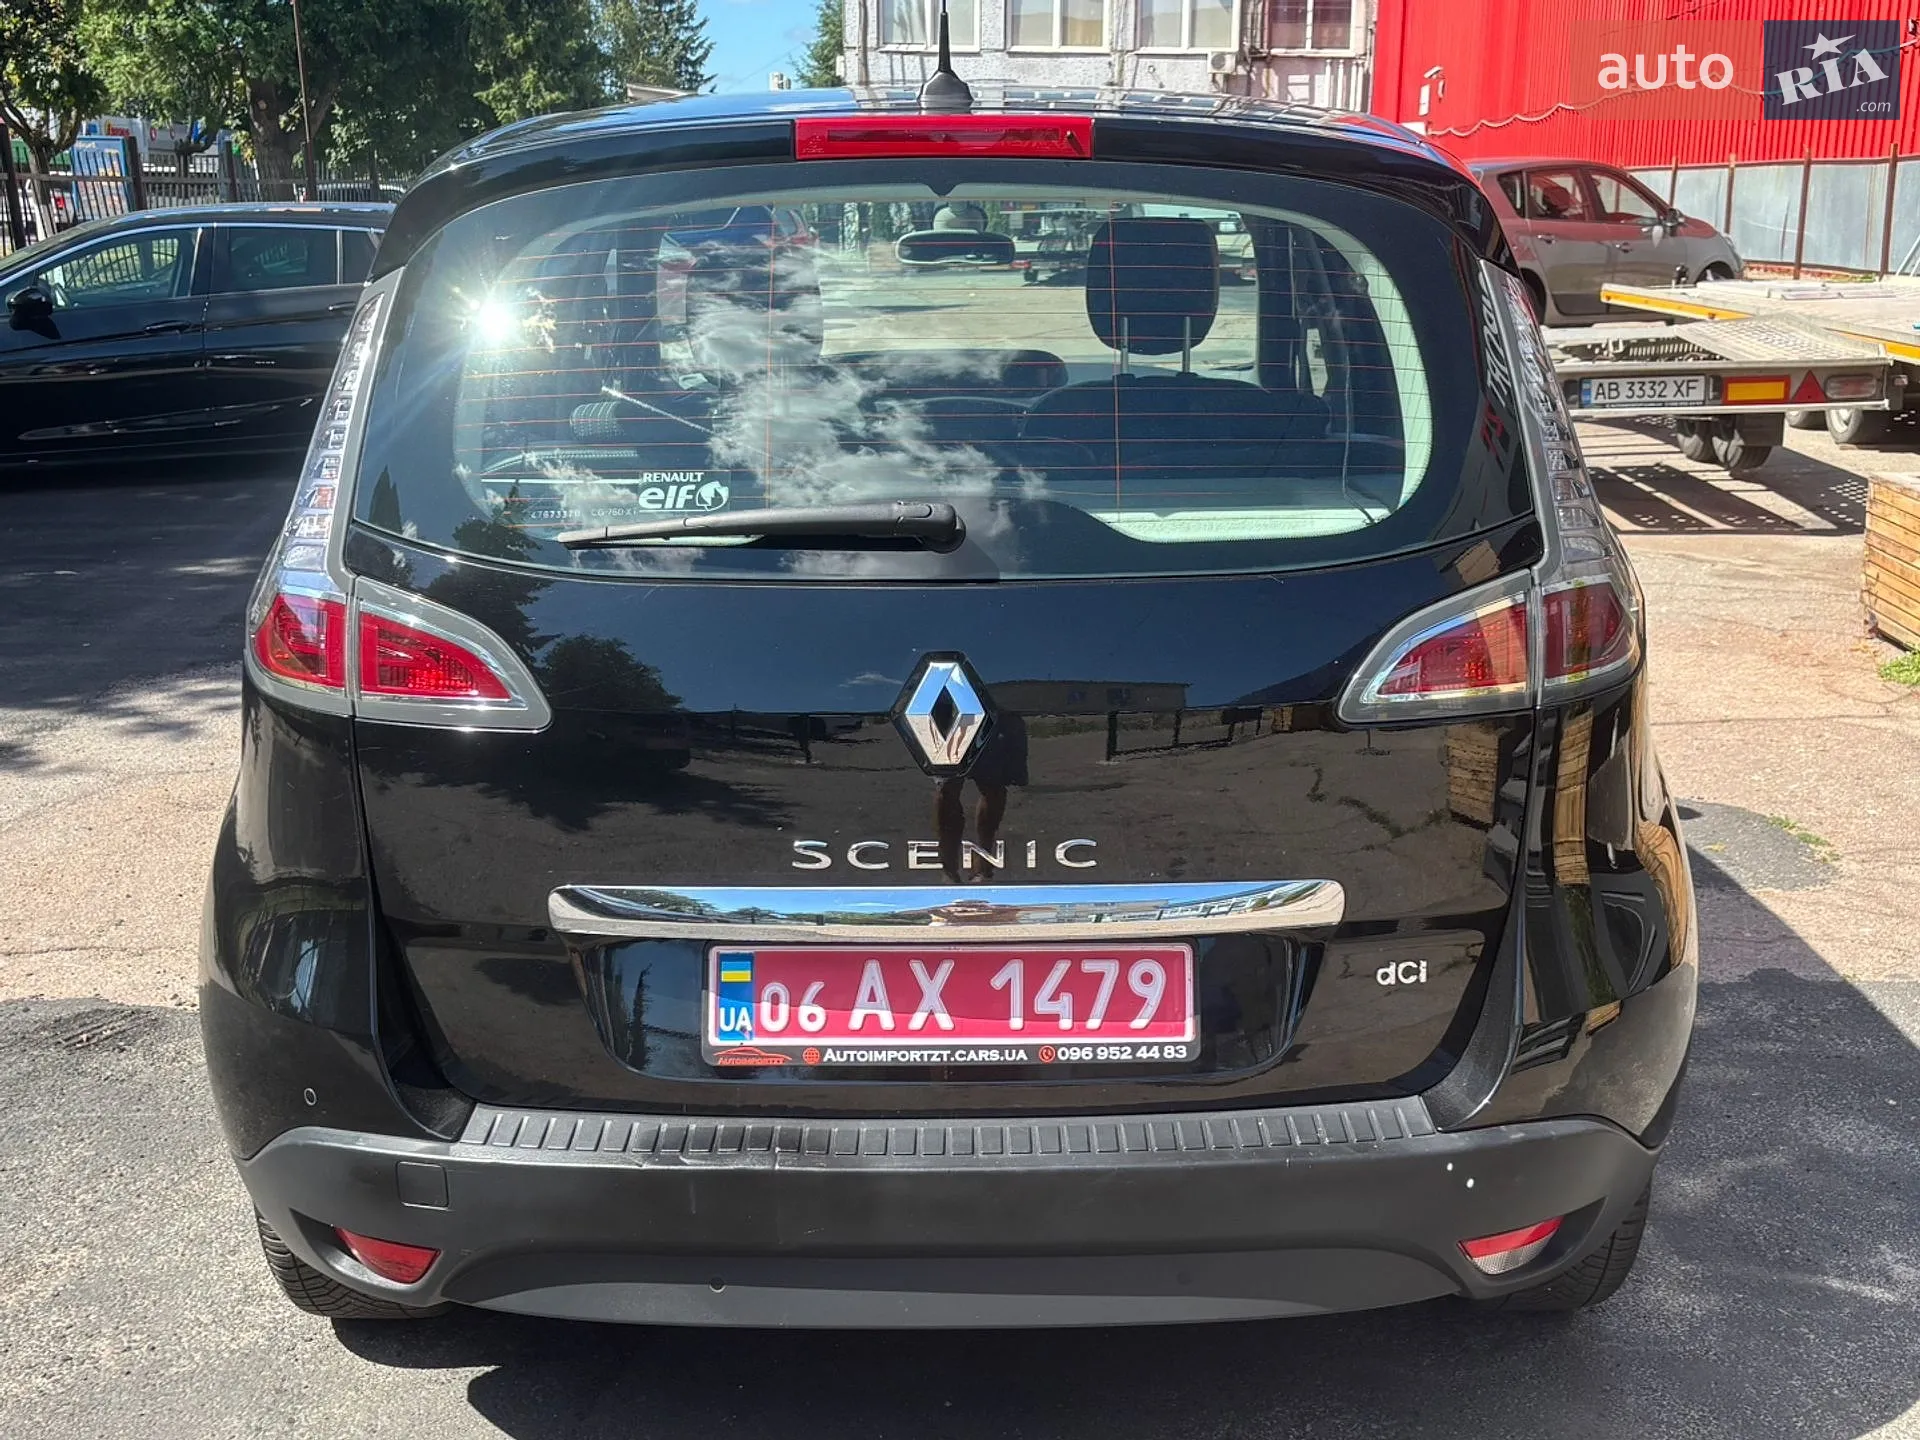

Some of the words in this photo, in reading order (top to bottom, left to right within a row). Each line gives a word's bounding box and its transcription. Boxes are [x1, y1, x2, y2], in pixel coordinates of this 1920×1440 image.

[1595, 382, 1620, 400] AB
[1626, 381, 1668, 398] 3332
[1673, 380, 1699, 397] XF
[643, 472, 704, 483] RENAULT
[639, 485, 696, 509] elf
[792, 838, 1097, 869] SCENIC
[1376, 960, 1427, 985] dCi
[759, 982, 826, 1032] 06
[847, 959, 955, 1031] AX
[990, 959, 1167, 1031] 1479
[720, 1007, 752, 1031] UA
[1057, 1047, 1093, 1060] 096
[1096, 1046, 1132, 1060] 952
[1136, 1046, 1160, 1059] 44
[1163, 1045, 1188, 1059] 83
